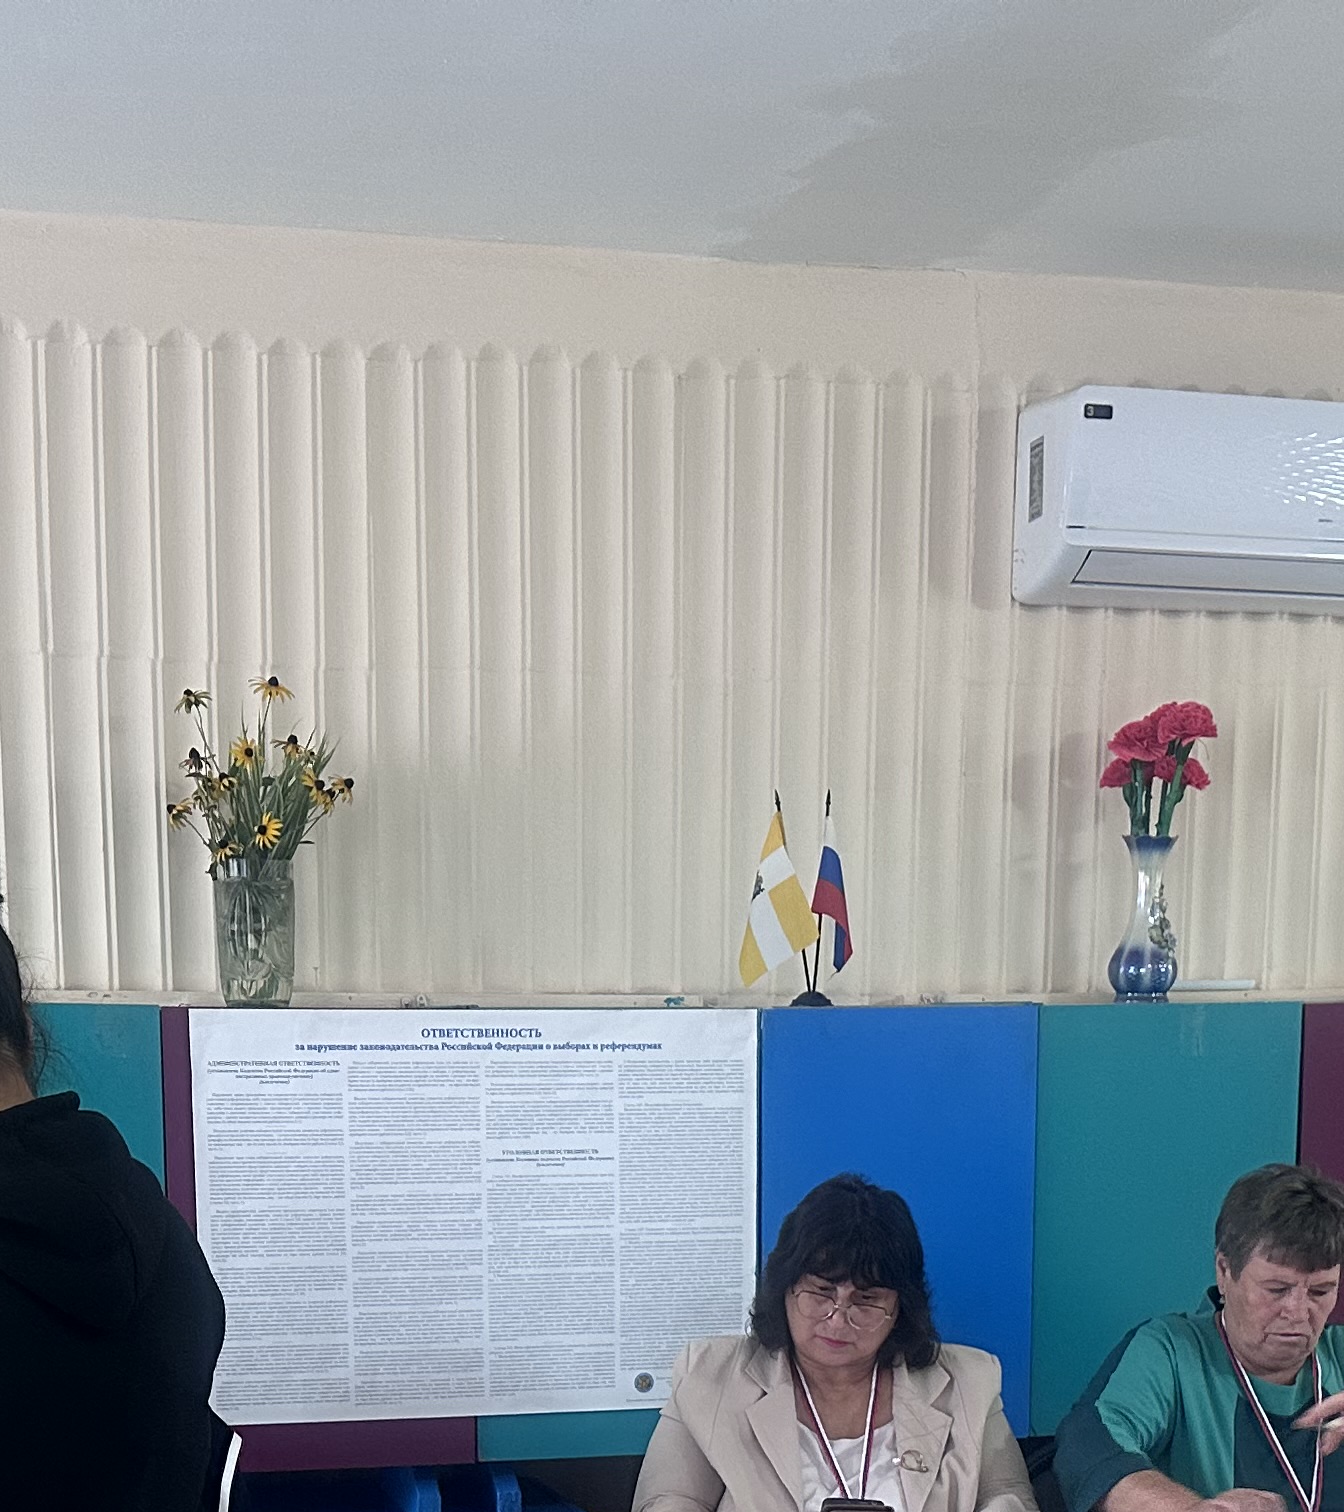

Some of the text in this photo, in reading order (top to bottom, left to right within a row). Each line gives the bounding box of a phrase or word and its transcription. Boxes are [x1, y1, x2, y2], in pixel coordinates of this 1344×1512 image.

[421, 1028, 542, 1039] ОТВЕТСТВЕННОСТЬ
[295, 1043, 305, 1051] за
[307, 1042, 358, 1053] нарушение
[359, 1042, 440, 1052] законодательства
[441, 1041, 493, 1051] Российской
[495, 1042, 544, 1052] Федерации
[553, 1041, 590, 1052] выборах
[600, 1041, 663, 1053] референдумах
